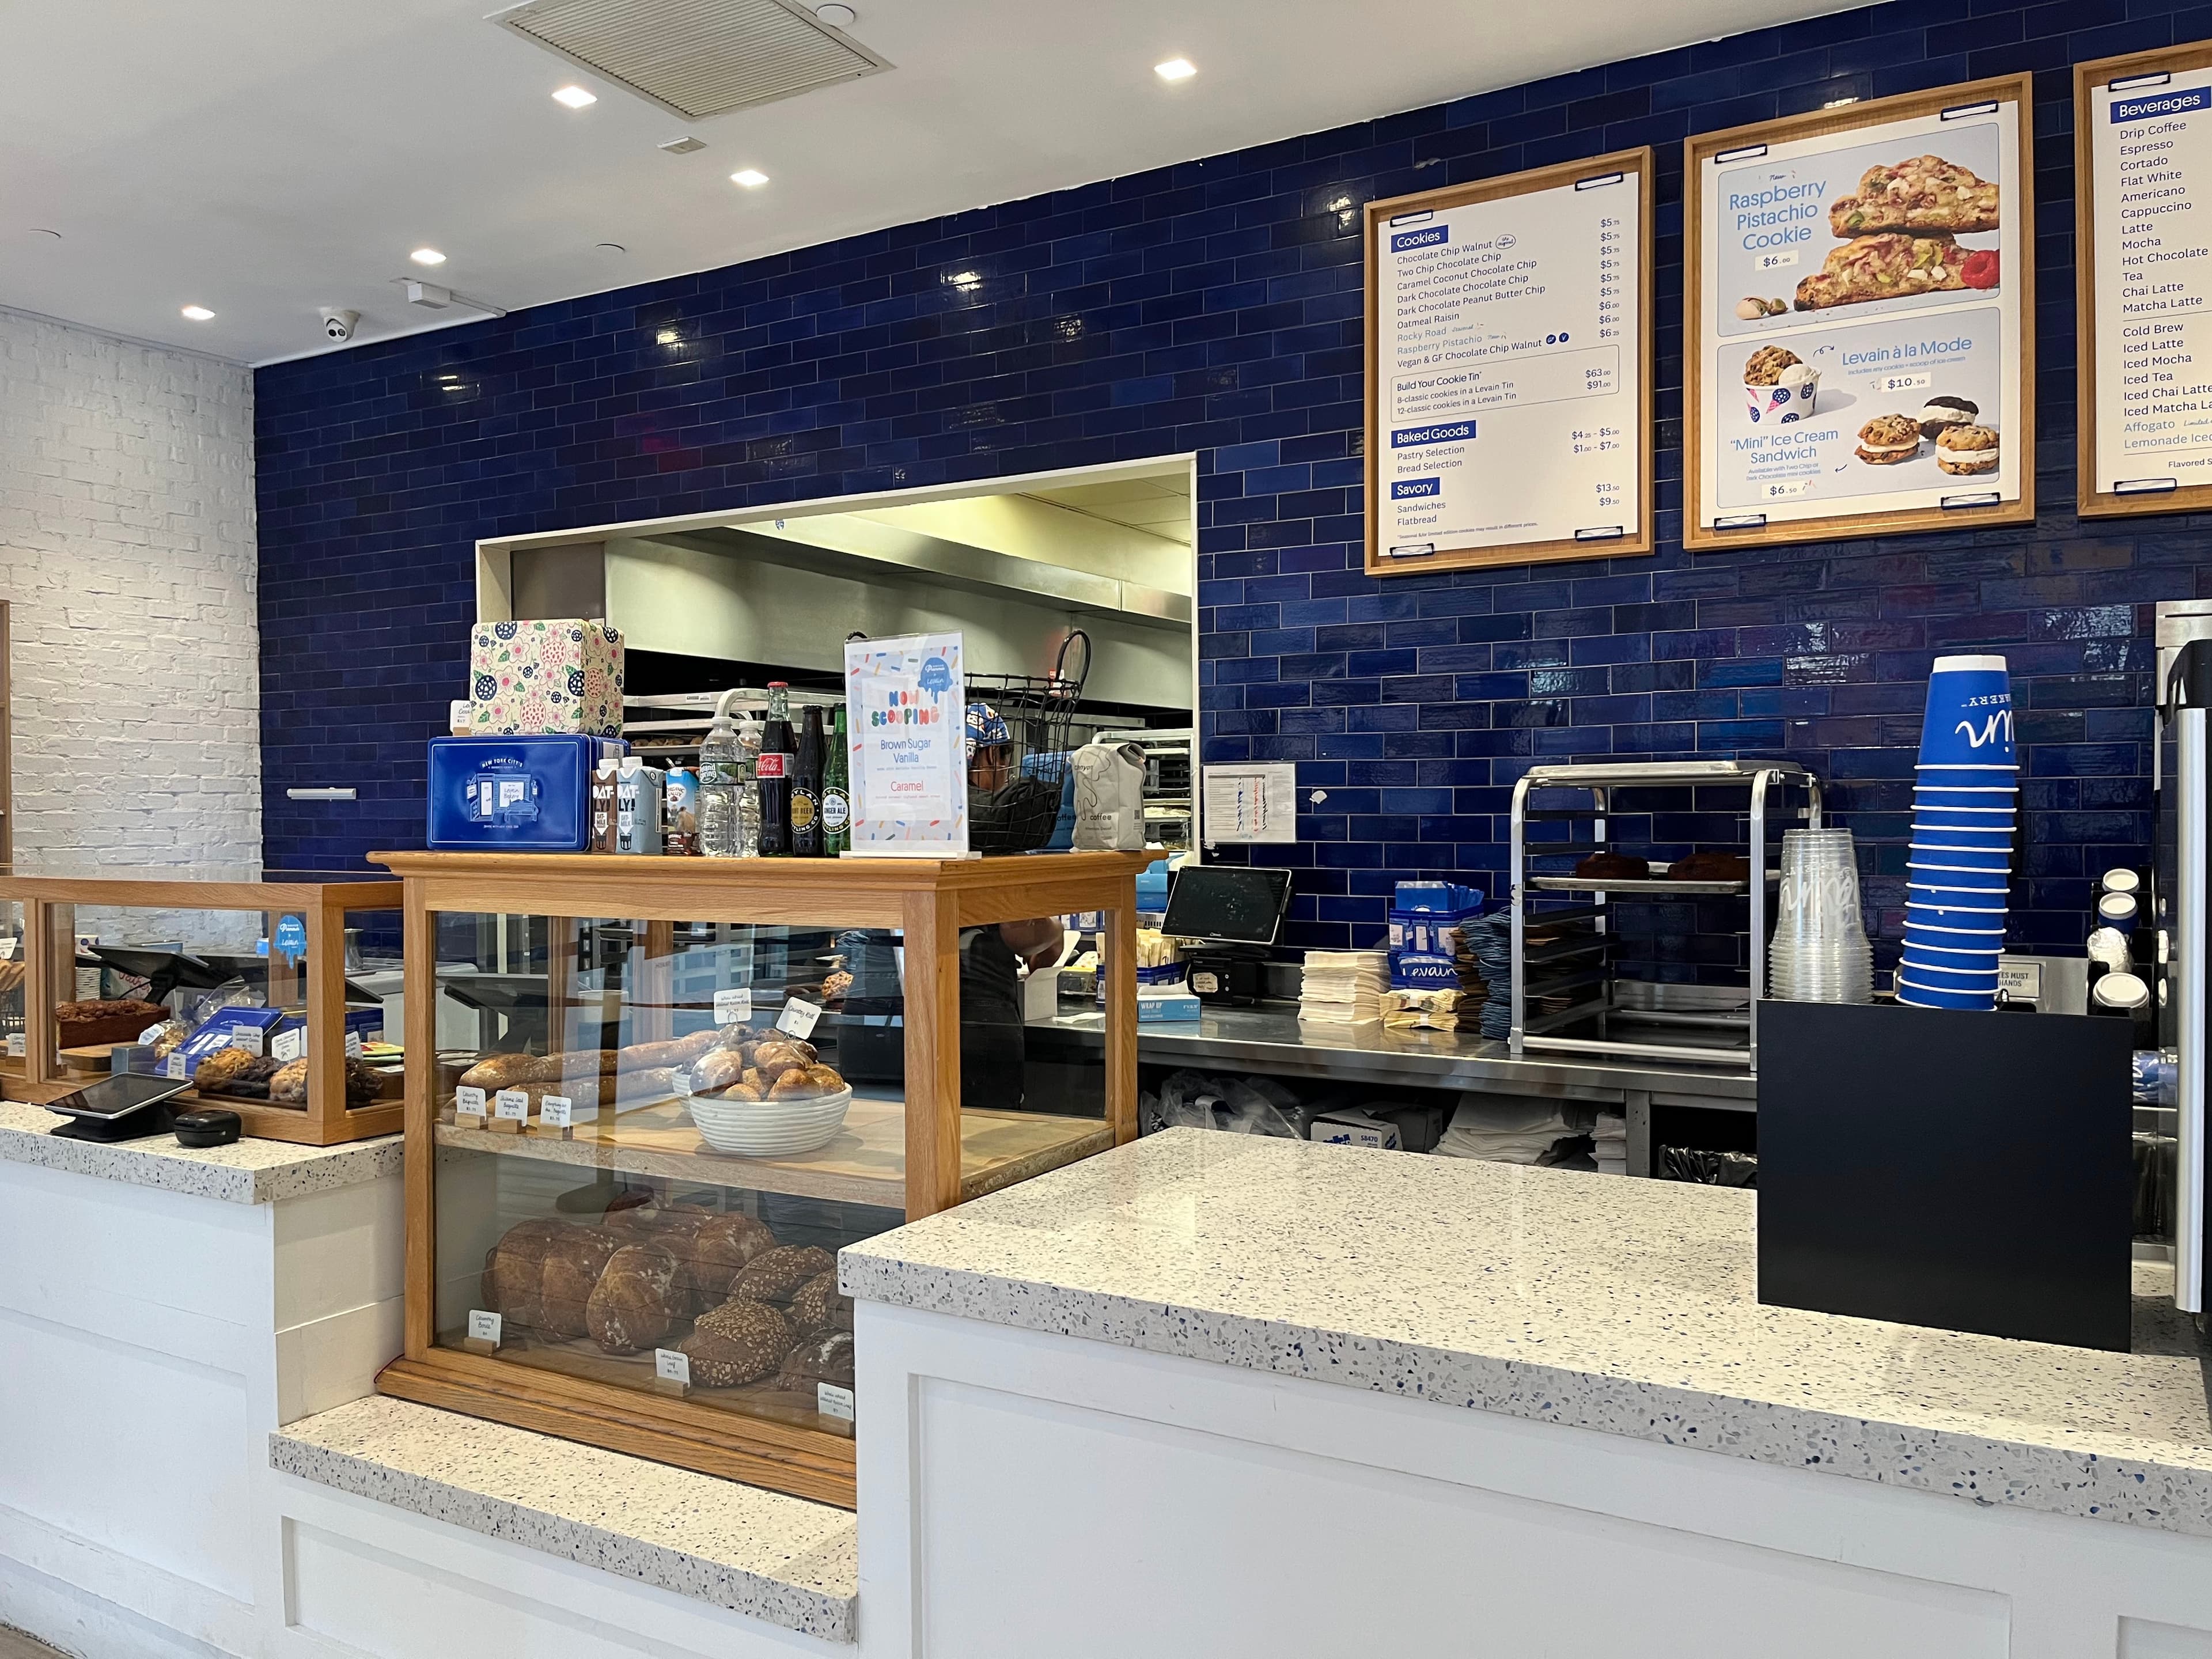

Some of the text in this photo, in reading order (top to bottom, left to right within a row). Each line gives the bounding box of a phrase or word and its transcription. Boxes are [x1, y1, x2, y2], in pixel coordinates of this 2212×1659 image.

[2119, 94, 2200, 118] Beverages
[2120, 121, 2187, 139] Drip Coffee
[2120, 140, 2173, 156] Espresso
[2120, 157, 2168, 171] Cortado
[2121, 170, 2182, 187] Flat White
[1729, 181, 1826, 210] Raspberry
[2122, 186, 2186, 203] Americano
[1736, 203, 1818, 230] Pistachio
[2122, 201, 2192, 218] Cappuccino
[2122, 222, 2153, 234] Latte
[1397, 232, 1440, 248] Cookies
[1743, 225, 1812, 251] Cookie
[2122, 237, 2161, 250] Mocha
[1397, 252, 1438, 264] Chocolate
[1441, 247, 1460, 256] Chip
[1462, 241, 1492, 252] Walnut
[2122, 247, 2209, 266] Hot Chocolate
[1397, 253, 1501, 277] Two Chip Chocolate Chip
[1397, 260, 1537, 290] Caramel Coconut Chocolate Chip
[2123, 271, 2143, 281] Tea
[1397, 274, 1528, 304] Dark Chocolate Chocolate Chip
[2123, 282, 2184, 298] Chai Latte
[1397, 286, 1545, 316] Dark Chocolate Peanut Butter Chip
[2123, 296, 2203, 313] Matcha Latte
[1397, 313, 1459, 329] Oatmeal Raisin
[1397, 331, 1422, 342] Rocky
[1425, 327, 1446, 338] Road
[2123, 323, 2183, 337] Cold Brew
[1397, 343, 1440, 355] Raspberry
[1442, 335, 1482, 347] Pistachio
[1843, 337, 1972, 365] Levain à la Mode
[2124, 339, 2183, 353] Iced Latte
[1397, 339, 1541, 368] Vegan & GF Chocolate Chip Walnut
[2124, 354, 2192, 369] Iced Mocha
[1397, 380, 1416, 391] Build
[1418, 380, 1435, 388] Your
[1436, 374, 1467, 385] Cookie
[2124, 372, 2173, 385] Iced Tea
[1430, 389, 1458, 399] cookies
[1475, 383, 1499, 393] Levain
[2124, 390, 2148, 400] Iced
[2152, 386, 2178, 398] Chai
[1433, 400, 1461, 410] cookies
[1478, 395, 1502, 404] Levain
[2124, 406, 2149, 416] Iced
[2153, 402, 2197, 414] Matcha
[1397, 425, 1469, 444] Baked Goods
[2124, 420, 2175, 433] Affogato
[1771, 435, 1791, 446] Ice
[1795, 430, 1838, 443] Cream
[2124, 435, 2187, 449] Lemonade
[1397, 446, 1464, 460] Pastry Selection
[1751, 446, 1816, 463] Sandwich
[1397, 459, 1462, 474] Bread Selection
[2169, 459, 2205, 468] Flavored
[1397, 483, 1433, 495] Savory
[1397, 502, 1446, 513] Sandwiches
[1397, 514, 1437, 526] Flatbread
[889, 690, 919, 707] NOW
[871, 706, 940, 727] SCOOPING
[881, 738, 931, 750] Brown Sugar
[893, 752, 919, 763] Vanilla
[891, 781, 923, 791] Caramel
